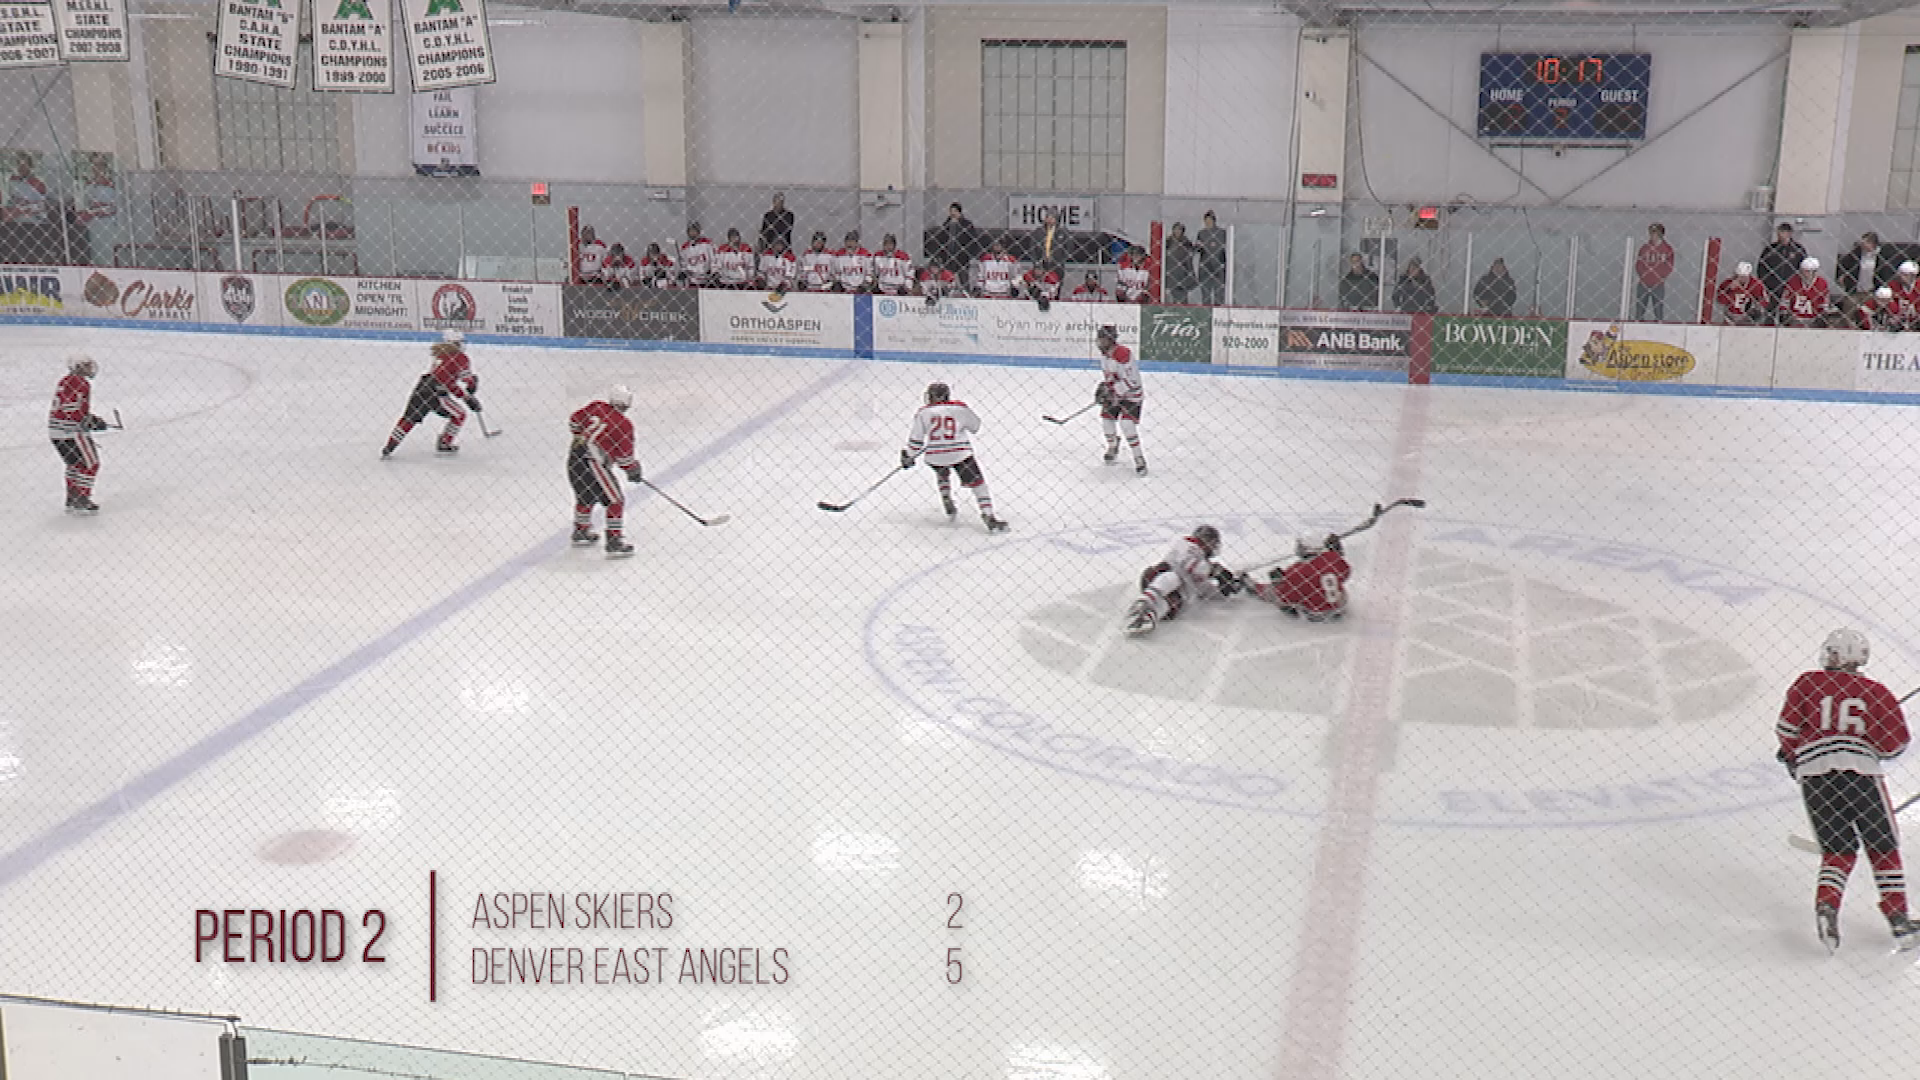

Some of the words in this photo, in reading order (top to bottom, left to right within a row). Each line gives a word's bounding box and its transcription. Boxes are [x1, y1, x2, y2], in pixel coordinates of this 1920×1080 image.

[229, 3, 274, 20] BANTAM
[321, 23, 366, 35] BANTAM
[414, 18, 459, 34] BANTAM
[239, 33, 282, 50] STATE
[224, 44, 292, 67] CHAMPIONS
[321, 54, 388, 67] CHAMPIONS
[417, 46, 485, 66] CHAMPIONS
[422, 62, 485, 81] 2005-2006
[1537, 58, 1603, 83] 10:17
[1490, 89, 1524, 101] HOME
[1601, 89, 1639, 102] GUEST
[357, 281, 402, 291] KITCHEN
[356, 293, 385, 302] OPEN
[572, 308, 620, 319] WOODY
[997, 316, 1031, 334] bryan
[1222, 335, 1269, 349] 920-2000
[1316, 331, 1356, 349] ANB
[1444, 322, 1555, 347] BOWDEN
[1862, 352, 1906, 371] THE
[928, 415, 957, 441] 29
[1819, 694, 1868, 734] 16
